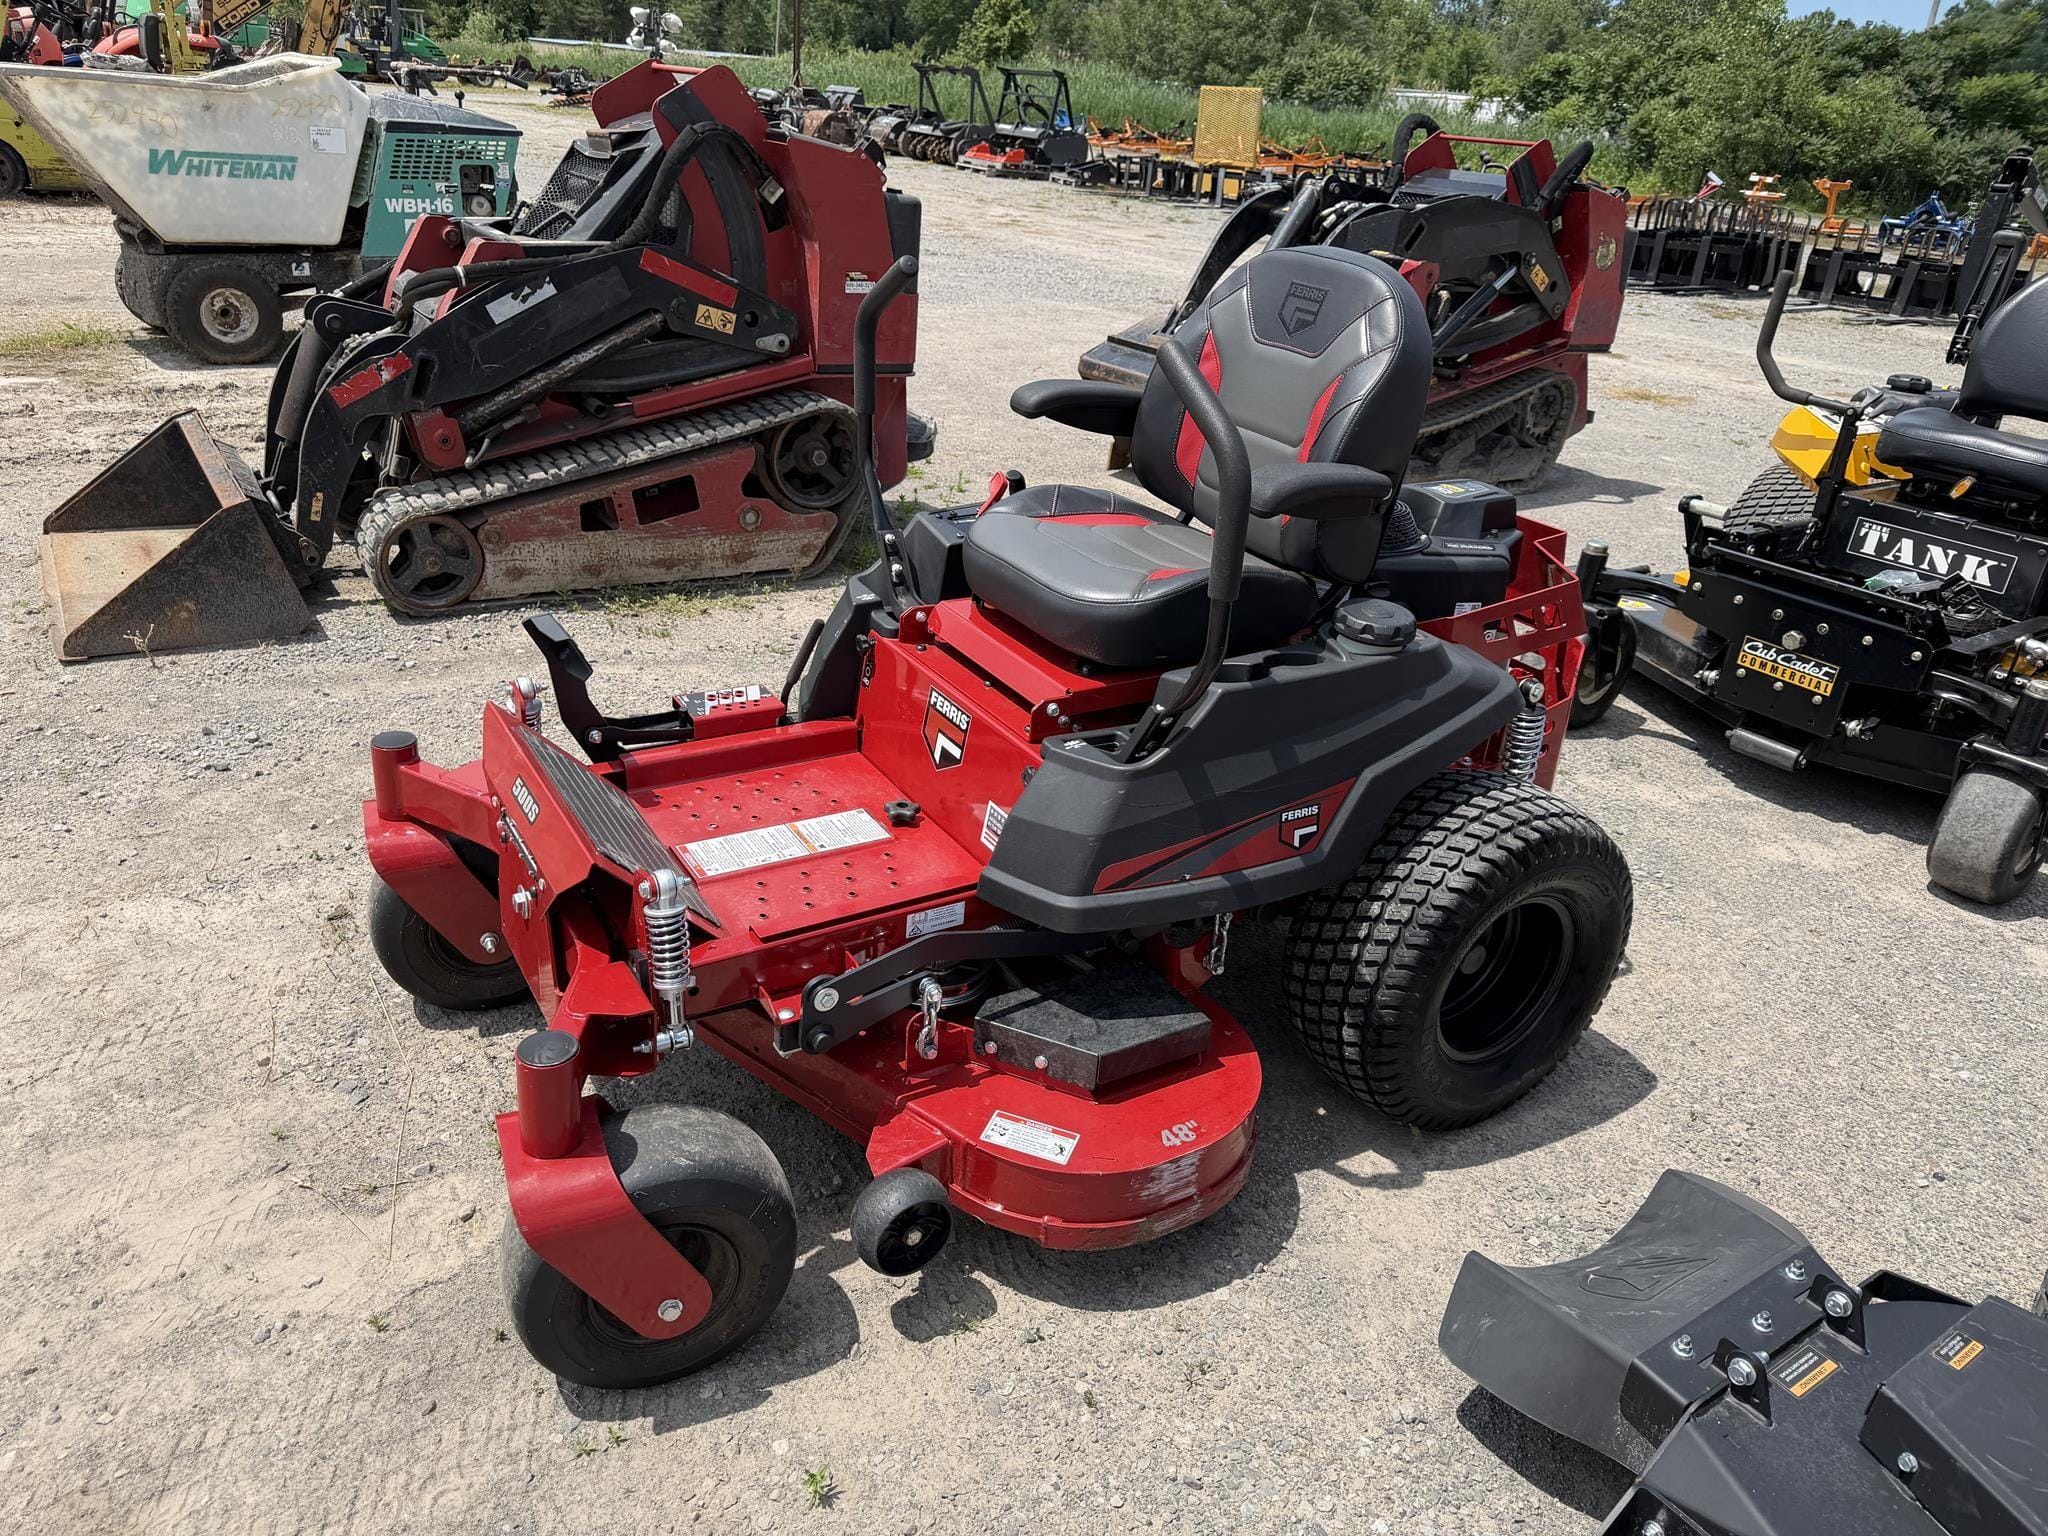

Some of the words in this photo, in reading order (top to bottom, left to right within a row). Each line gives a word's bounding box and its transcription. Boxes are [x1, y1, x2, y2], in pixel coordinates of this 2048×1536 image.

[218, 0, 261, 30] FORD
[148, 148, 298, 181] WHITEMAN
[1290, 284, 1326, 301] FERRIS
[1862, 521, 1891, 534] THE
[1859, 527, 1999, 587] TANK
[1740, 654, 1829, 694] COMMERCIAL
[1743, 641, 1777, 661] Cub
[1777, 653, 1836, 681] Cadet
[930, 690, 969, 730] FERRIS
[512, 777, 539, 822] 500S
[1281, 805, 1319, 822] FERRIS
[1161, 1119, 1198, 1147] 48"
